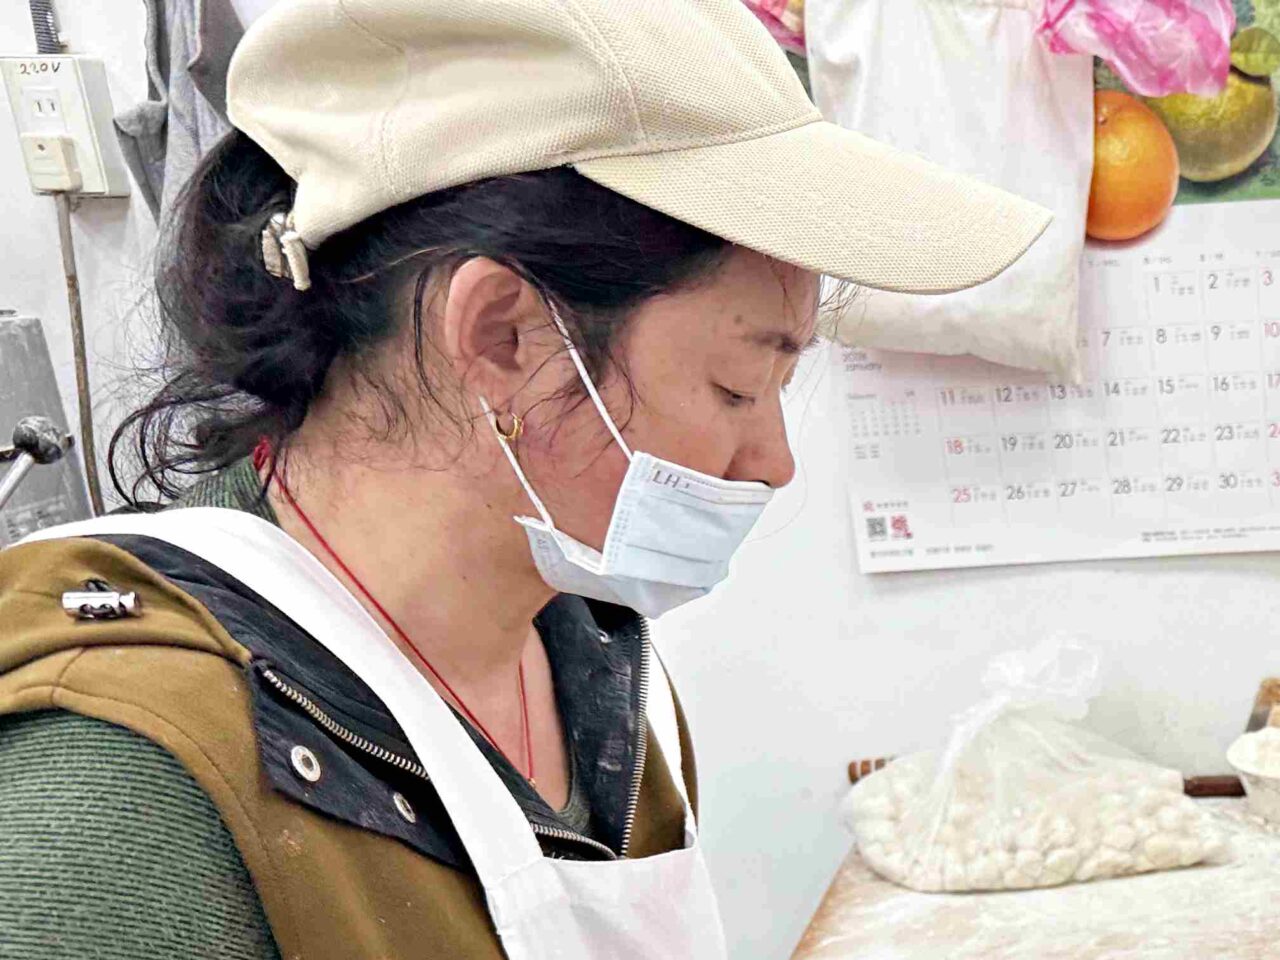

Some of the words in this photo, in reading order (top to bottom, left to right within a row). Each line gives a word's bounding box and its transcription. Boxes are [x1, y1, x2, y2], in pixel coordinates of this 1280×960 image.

[1152, 277, 1161, 292] 1
[1208, 273, 1219, 289] 2
[1262, 270, 1274, 285] 3
[1101, 331, 1111, 346] 7
[1156, 328, 1168, 344] 8
[1211, 325, 1222, 341] 9
[1263, 322, 1280, 338] 10
[942, 389, 957, 405] 11
[995, 386, 1013, 402] 12
[1050, 384, 1066, 400] 13
[1104, 381, 1121, 397] 14
[1158, 378, 1175, 394] 15
[1212, 376, 1230, 391] 16
[947, 439, 964, 454] 18
[1001, 436, 1017, 451] 19
[1054, 433, 1073, 449] 20
[1108, 431, 1125, 446] 21
[1162, 428, 1180, 443] 22
[1216, 425, 1234, 441] 23
[953, 487, 971, 503] 25
[1007, 484, 1025, 500] 26
[1060, 481, 1077, 497] 27
[1113, 478, 1131, 494] 28
[1166, 476, 1184, 491] 29
[1219, 474, 1238, 489] 30
